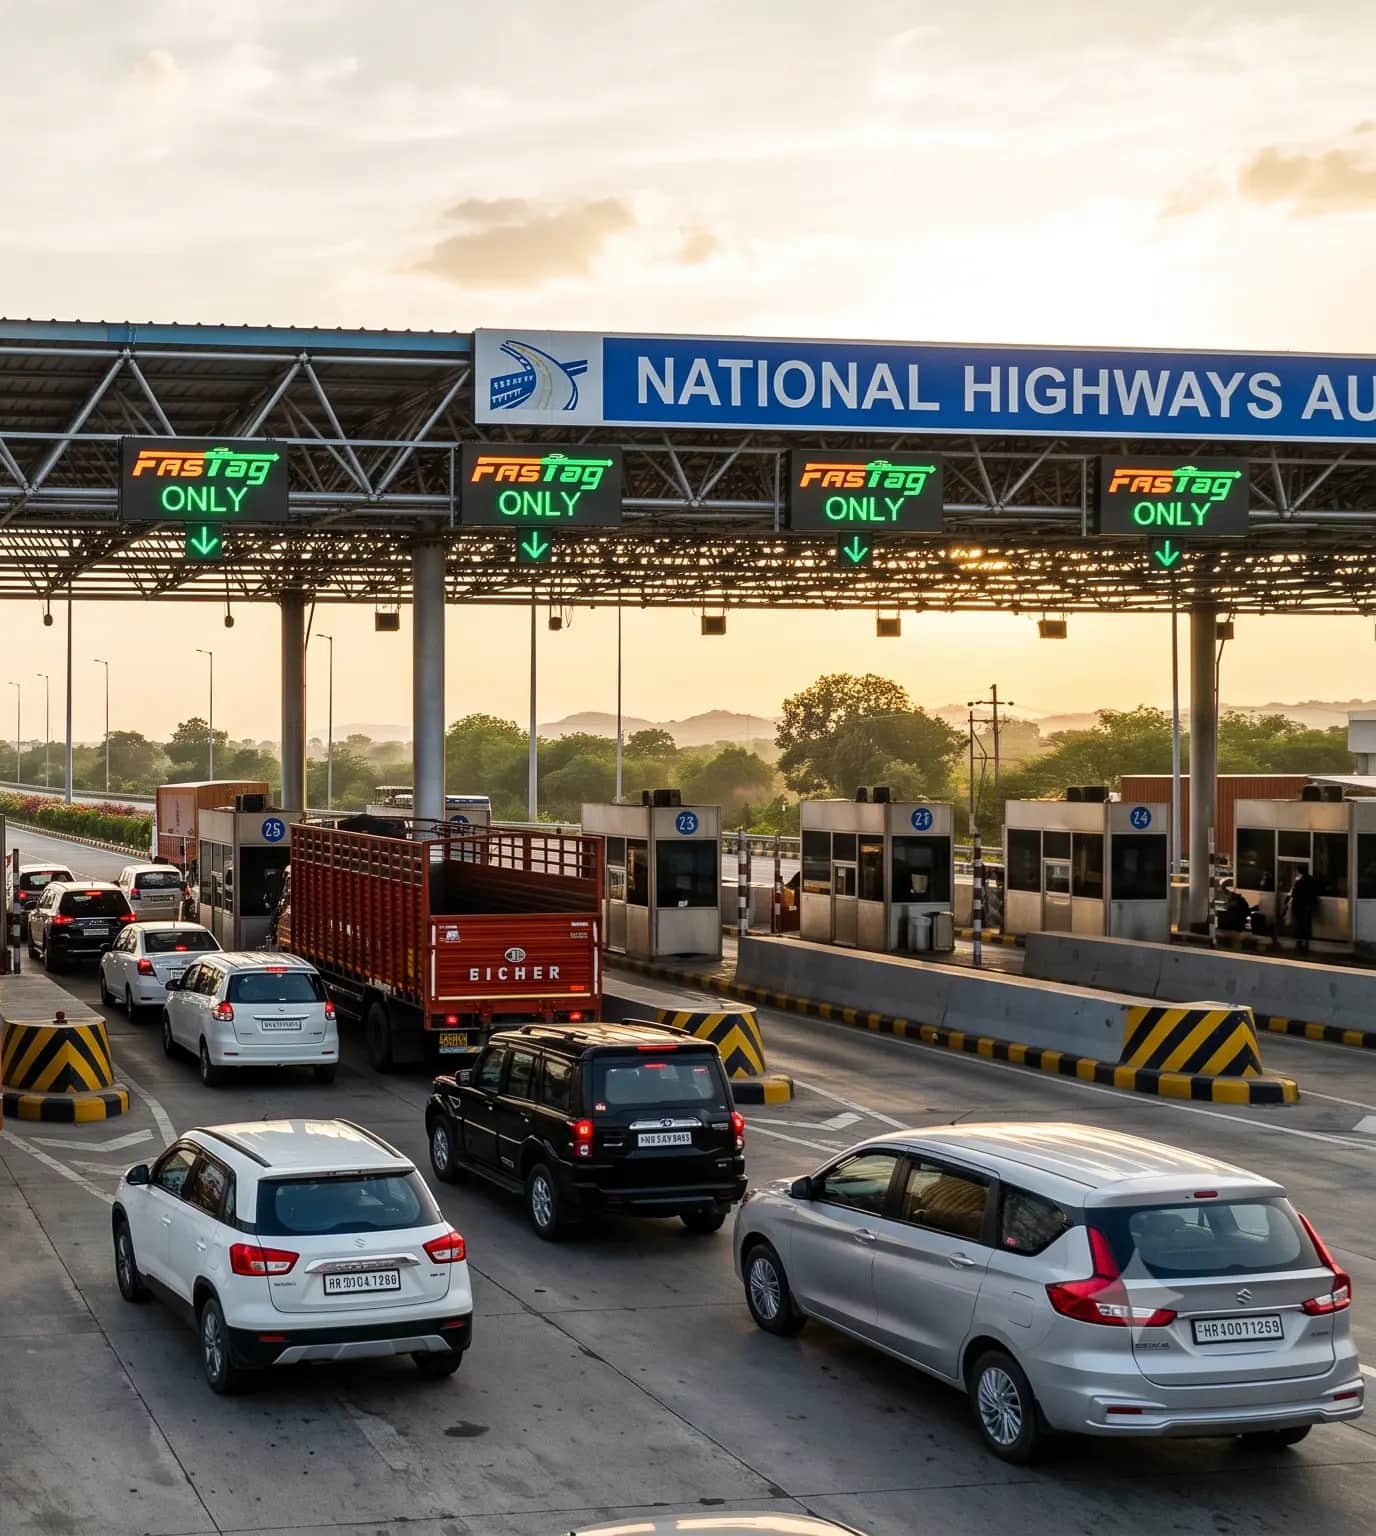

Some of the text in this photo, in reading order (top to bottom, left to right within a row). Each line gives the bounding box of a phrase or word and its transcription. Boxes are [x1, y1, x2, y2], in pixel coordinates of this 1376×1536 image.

[638, 356, 1376, 422] NATIONAL HIGHWAYS AU
[161, 486, 248, 512] ONLY
[498, 491, 581, 517] ONLY
[825, 497, 904, 521] ONLY
[1132, 502, 1210, 526] ONLY
[265, 822, 281, 837] 25
[680, 816, 695, 830] 23
[469, 966, 560, 981] EICHER
